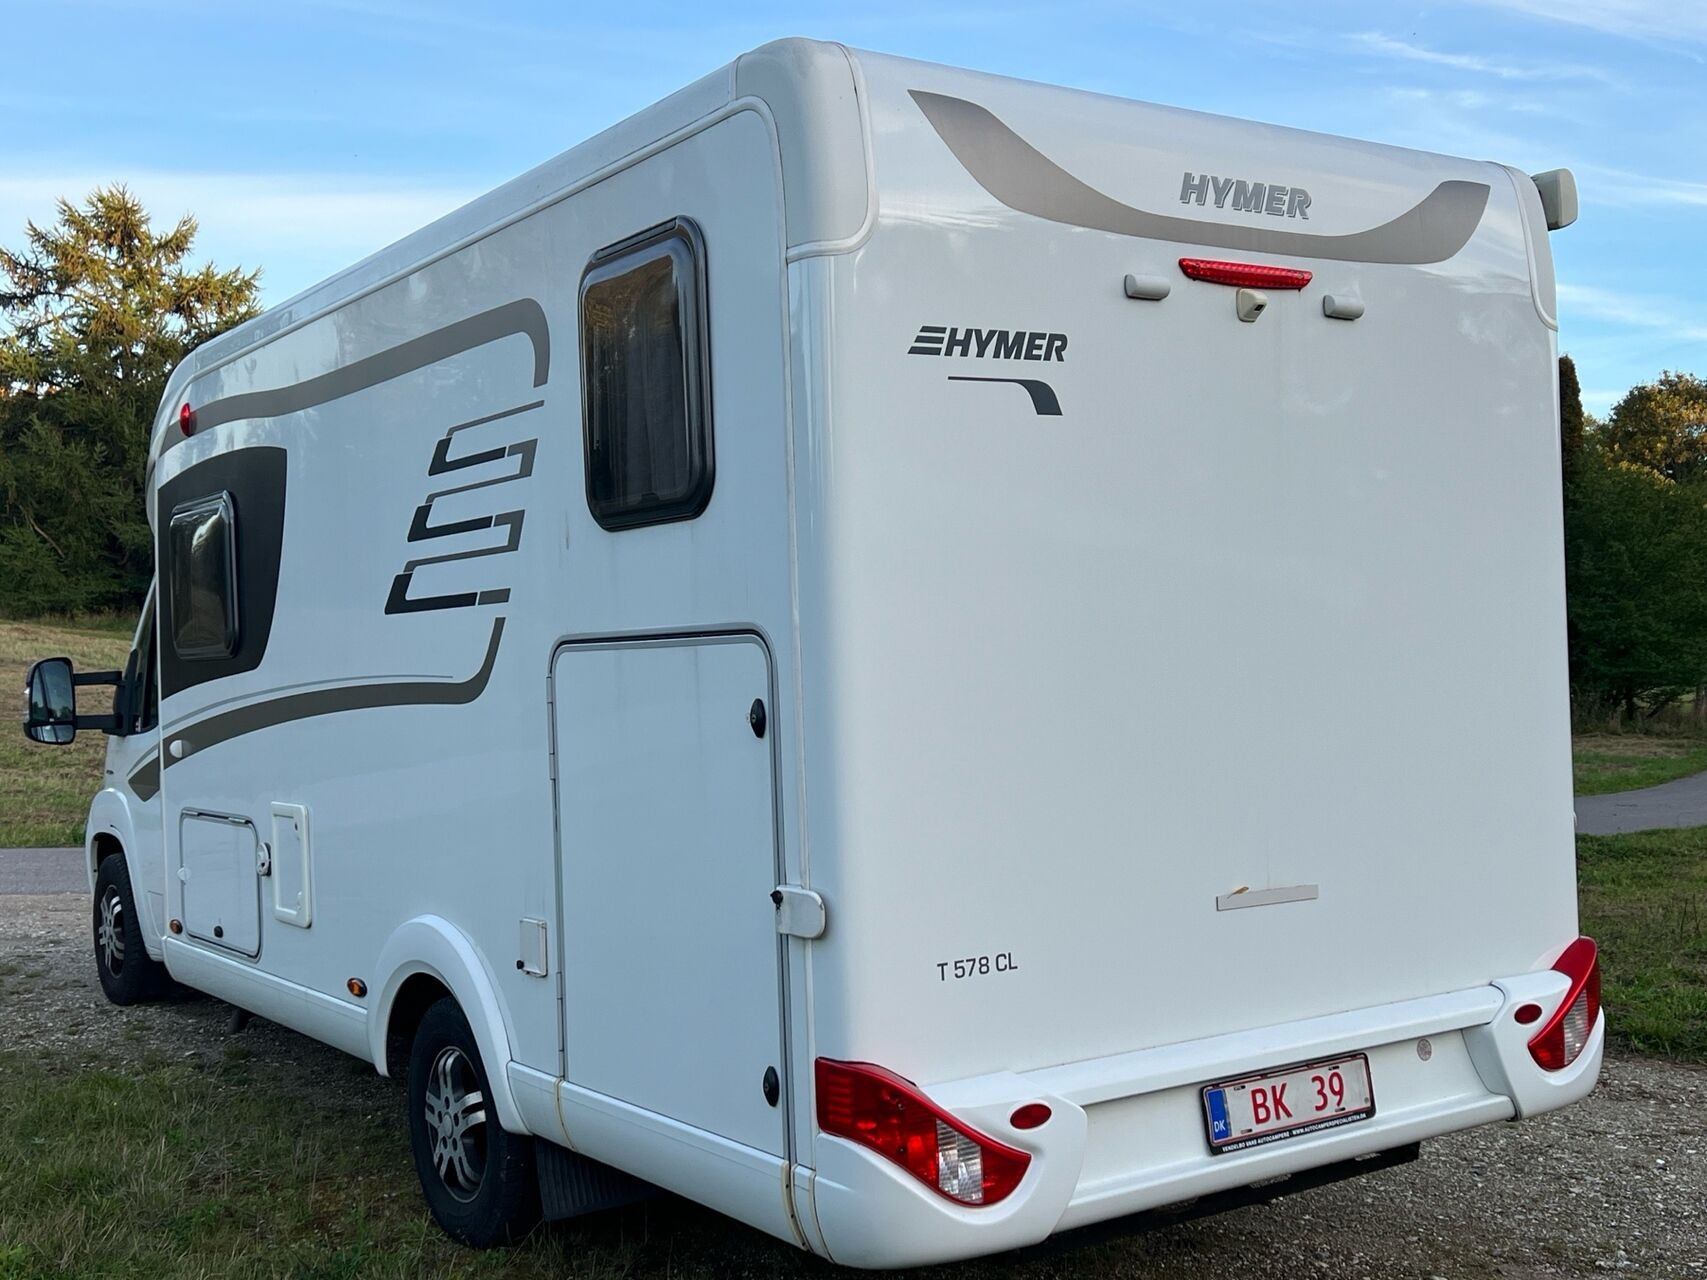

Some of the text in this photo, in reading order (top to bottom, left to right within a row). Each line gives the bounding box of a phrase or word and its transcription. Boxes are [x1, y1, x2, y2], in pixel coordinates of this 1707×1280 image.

[1180, 172, 1312, 220] HYMER
[944, 327, 1068, 362] HYMER
[937, 952, 1018, 981] T 578 CL
[1251, 1071, 1345, 1125] BK 39
[1214, 1119, 1226, 1133] DK
